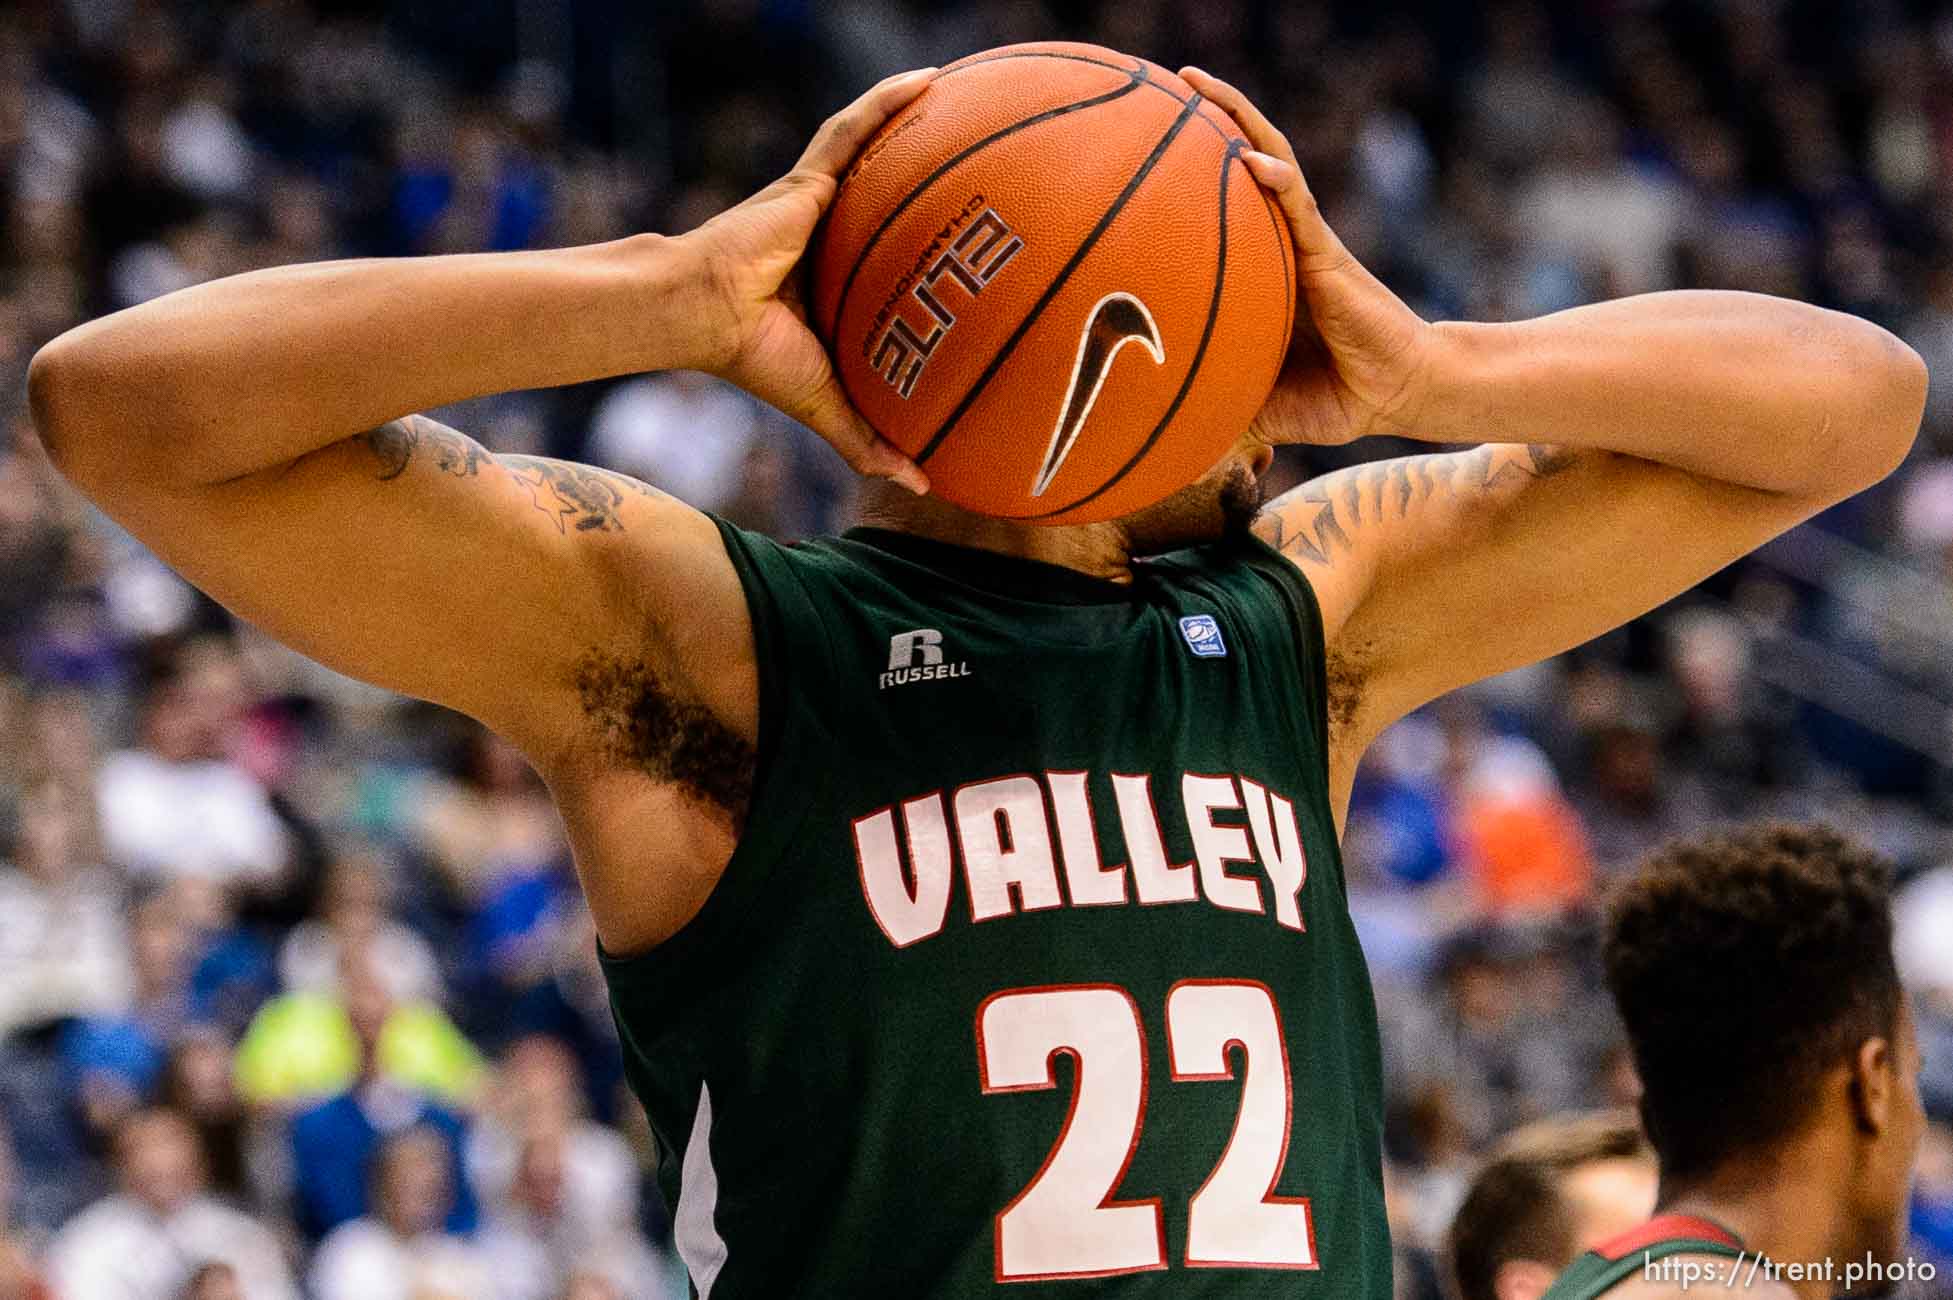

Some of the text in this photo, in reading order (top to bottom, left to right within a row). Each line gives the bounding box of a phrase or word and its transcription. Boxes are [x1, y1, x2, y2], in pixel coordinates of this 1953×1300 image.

[863, 194, 985, 357] CHAMPIONSHIP
[871, 207, 1025, 401] ELITE
[879, 661, 972, 690] RUSSELL
[851, 769, 1307, 949] VALLEY
[976, 978, 1320, 1283] 22
